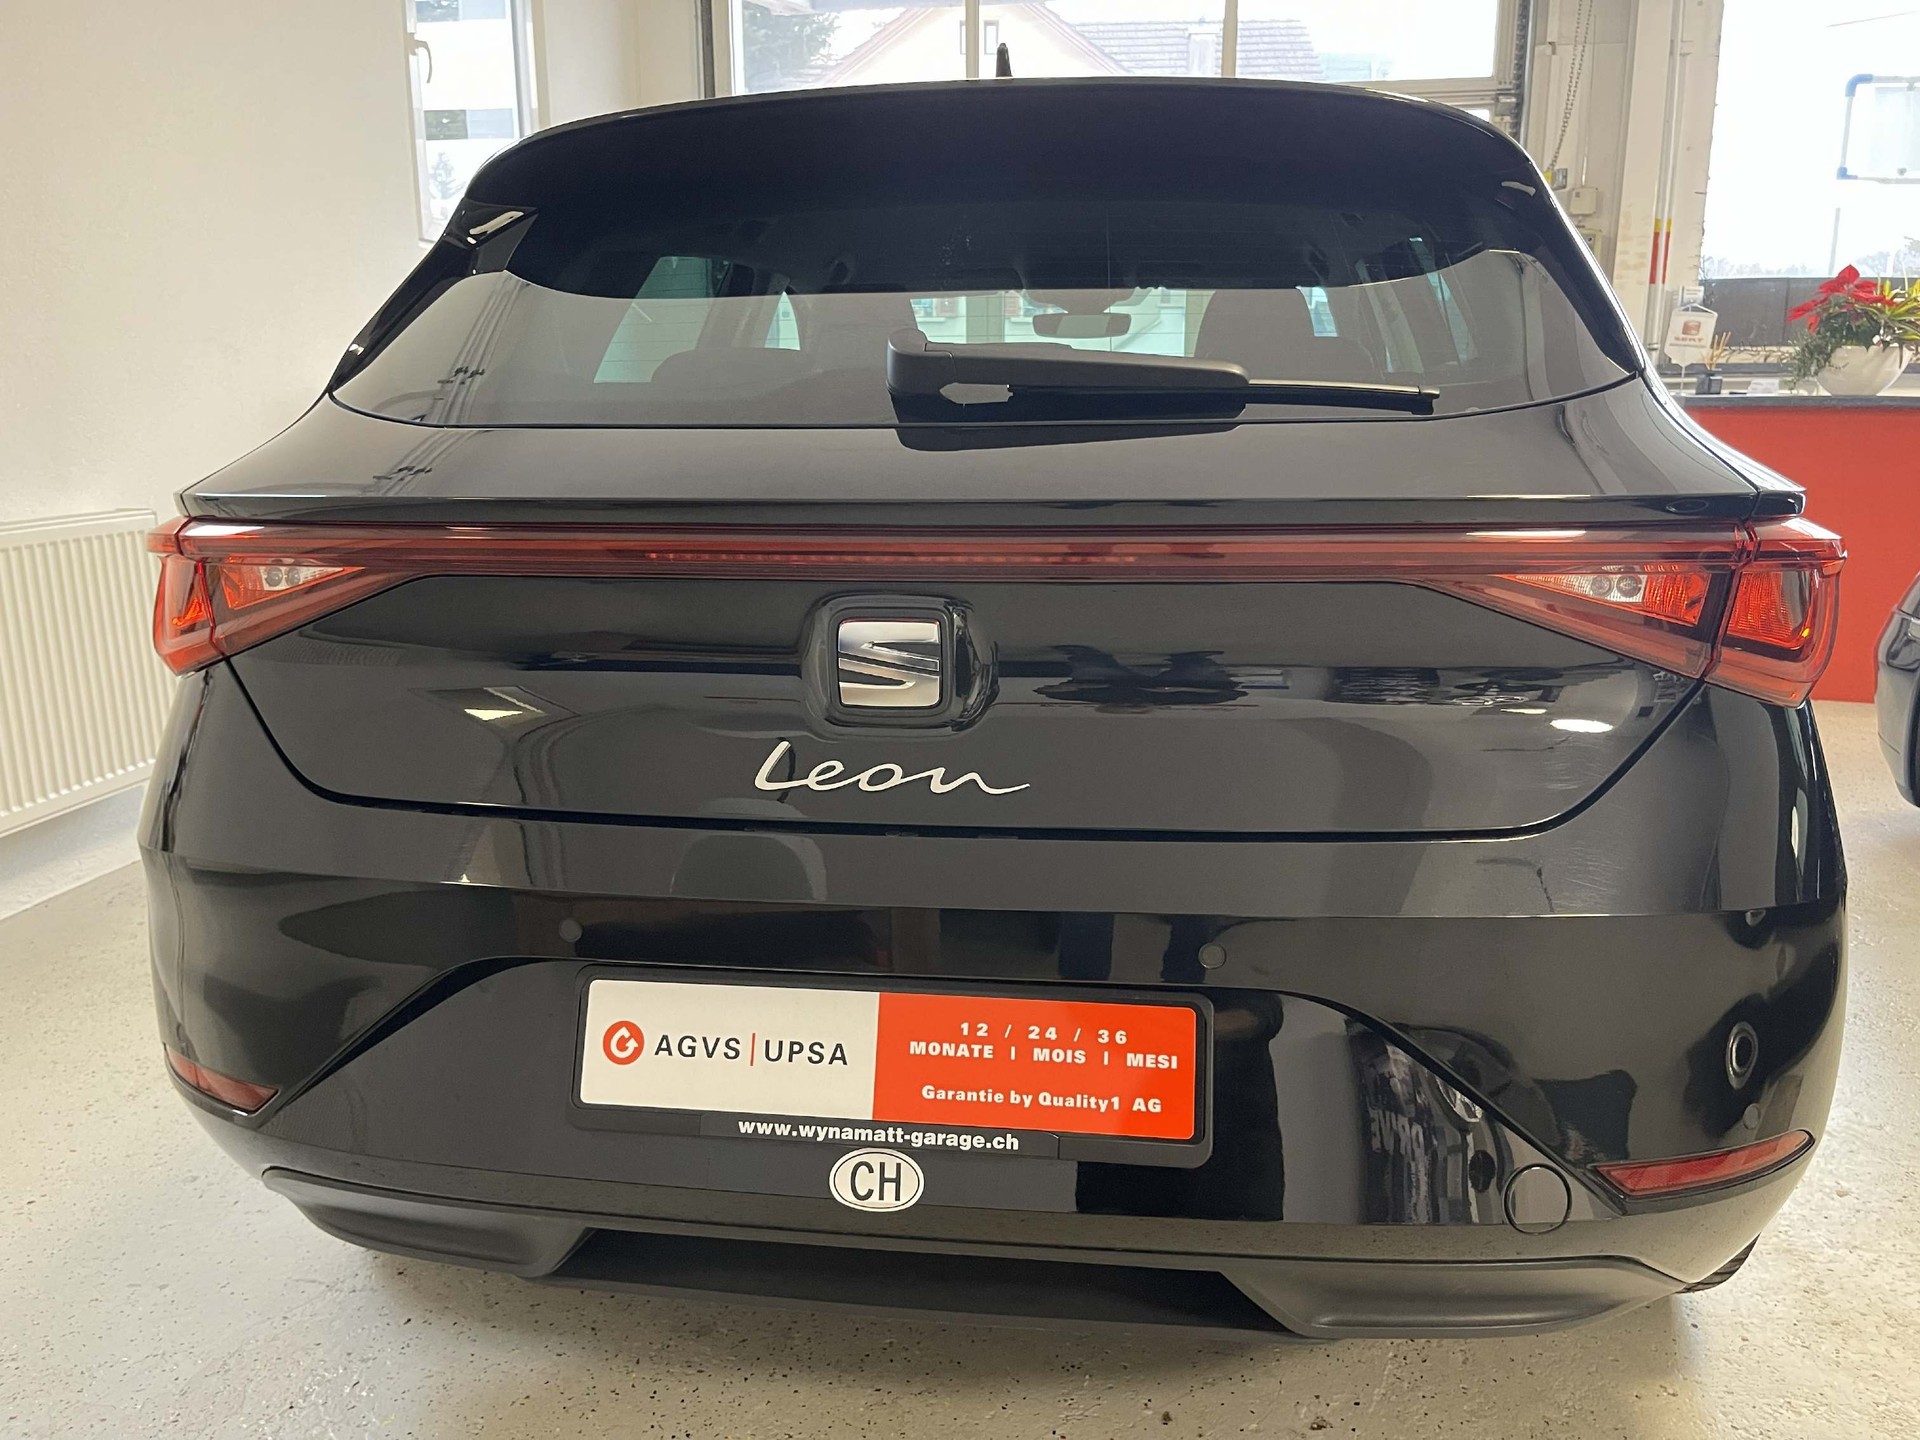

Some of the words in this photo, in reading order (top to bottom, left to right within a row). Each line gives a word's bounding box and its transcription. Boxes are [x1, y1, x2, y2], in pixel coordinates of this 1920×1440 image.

[754, 740, 1031, 795] Leon
[960, 1022, 989, 1038] 12
[1028, 1025, 1058, 1041] 24
[1097, 1029, 1128, 1045] 36
[654, 1034, 741, 1060] AGVS
[764, 1039, 849, 1066] UPSA
[909, 1041, 994, 1059] MONATE
[1032, 1048, 1087, 1065] MOIS
[1126, 1053, 1178, 1070] MESI
[921, 1085, 1005, 1104] Garantie
[1009, 1090, 1033, 1108] by
[1038, 1091, 1120, 1113] Quality1
[1132, 1098, 1162, 1113] AG
[738, 1120, 1020, 1151] www.wynamatt-garage.ch
[850, 1160, 902, 1202] CH
